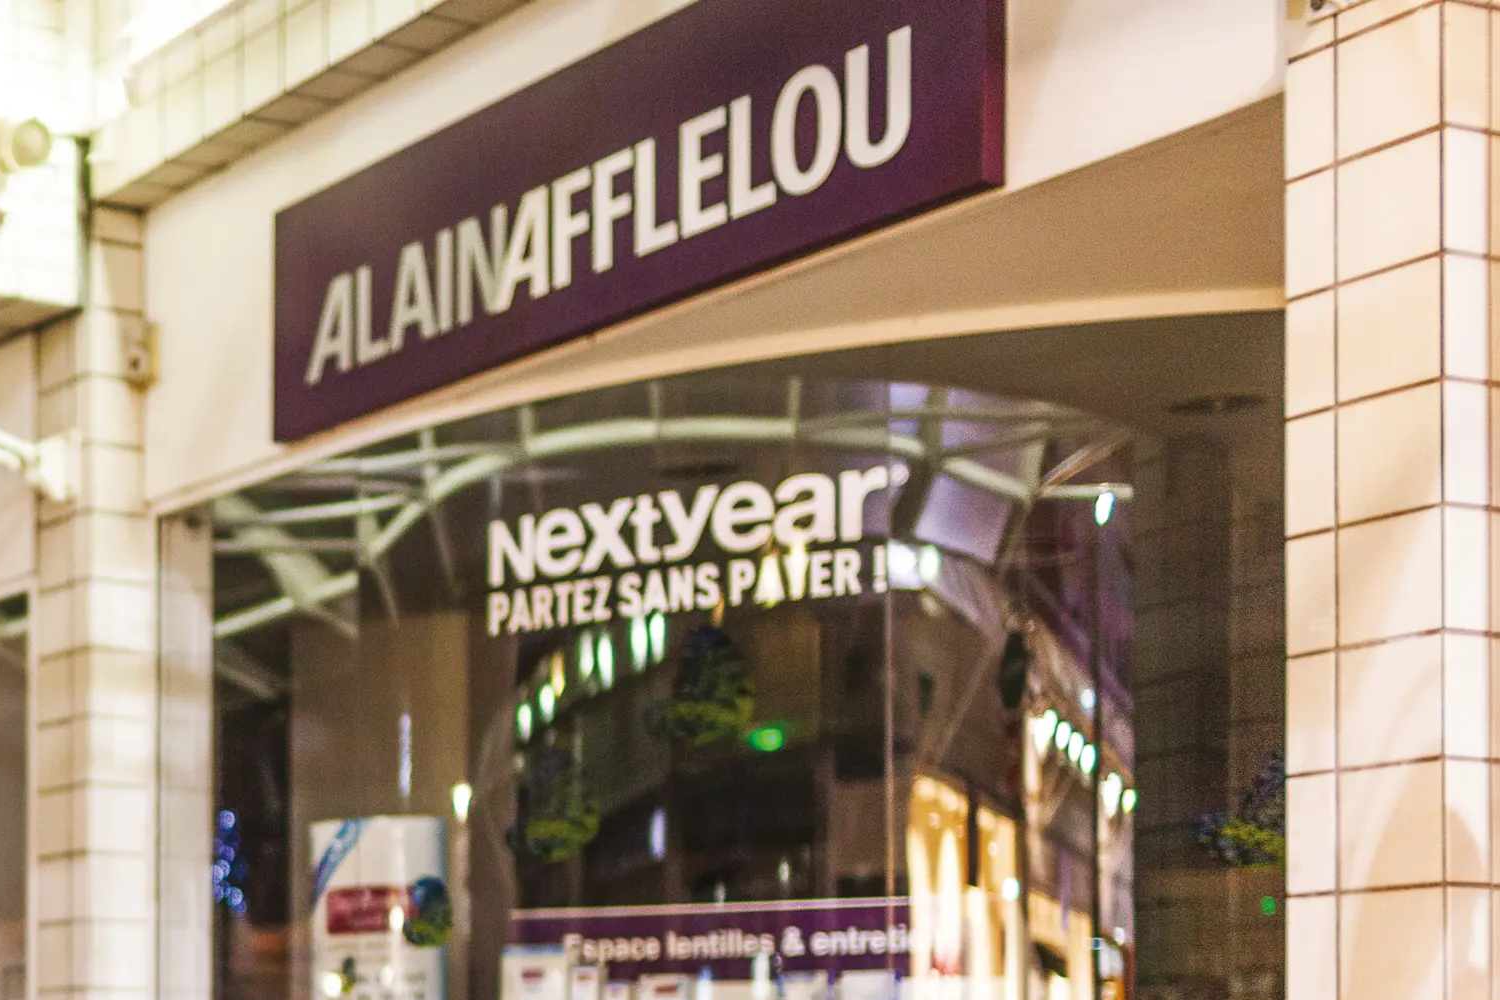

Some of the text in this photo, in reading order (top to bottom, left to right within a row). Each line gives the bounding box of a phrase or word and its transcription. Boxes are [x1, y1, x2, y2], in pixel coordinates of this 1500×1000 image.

[304, 24, 912, 387] ALAIN AFFLELOU
[487, 576, 612, 637] PARTEZ
[617, 562, 720, 618] SANS
[729, 545, 863, 608] PAYER
[666, 926, 776, 958] lentilles
